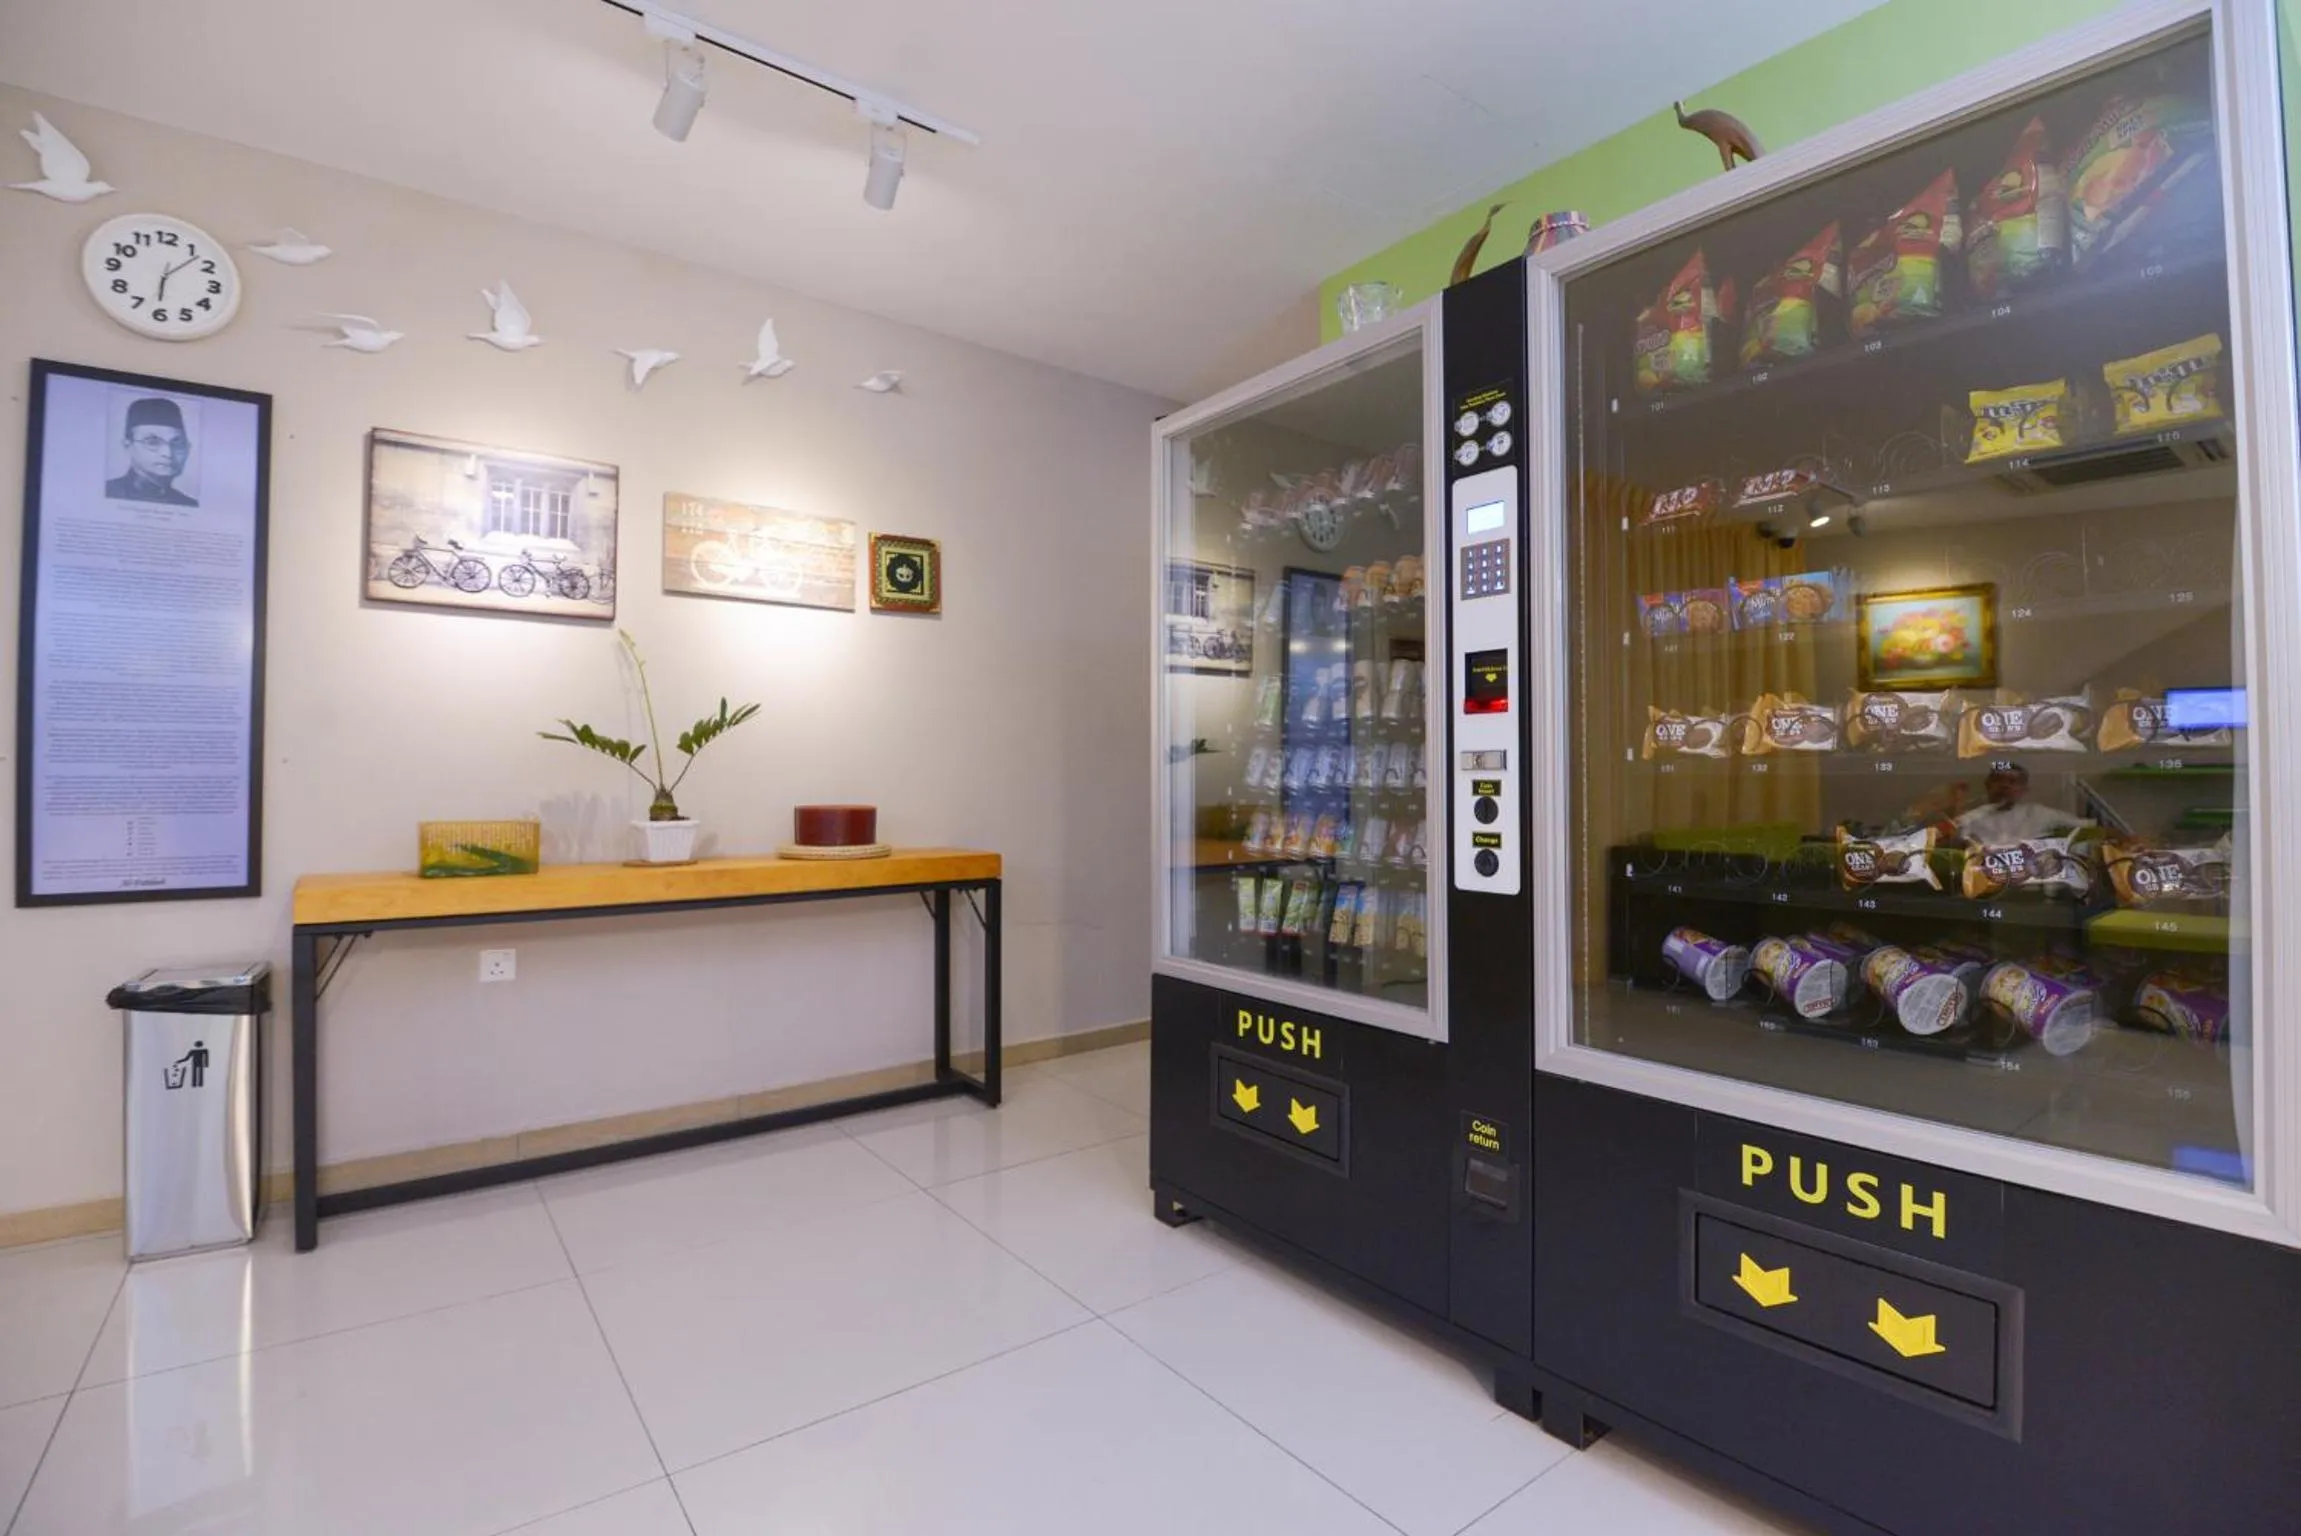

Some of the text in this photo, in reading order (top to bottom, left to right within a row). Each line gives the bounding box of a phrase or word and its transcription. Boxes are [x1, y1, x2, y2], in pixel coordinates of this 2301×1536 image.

[132, 232, 151, 246] 11
[156, 230, 179, 246] 12
[113, 243, 137, 258] 10
[187, 244, 195, 256] 1
[105, 257, 122, 271] 9
[201, 260, 216, 274] 2
[111, 279, 128, 293] 8
[207, 280, 222, 294] 3
[131, 296, 145, 309] 7
[196, 297, 211, 311] 4
[152, 308, 168, 322] 6
[179, 308, 193, 322] 5
[1475, 835, 1498, 845] Change
[1985, 850, 2024, 868] ONE
[1983, 910, 2002, 918] 144
[1238, 1009, 1321, 1059] PUSH
[1472, 1120, 1497, 1138] Coin
[1469, 1133, 1500, 1151] return
[1741, 1144, 1946, 1239] PUSH
